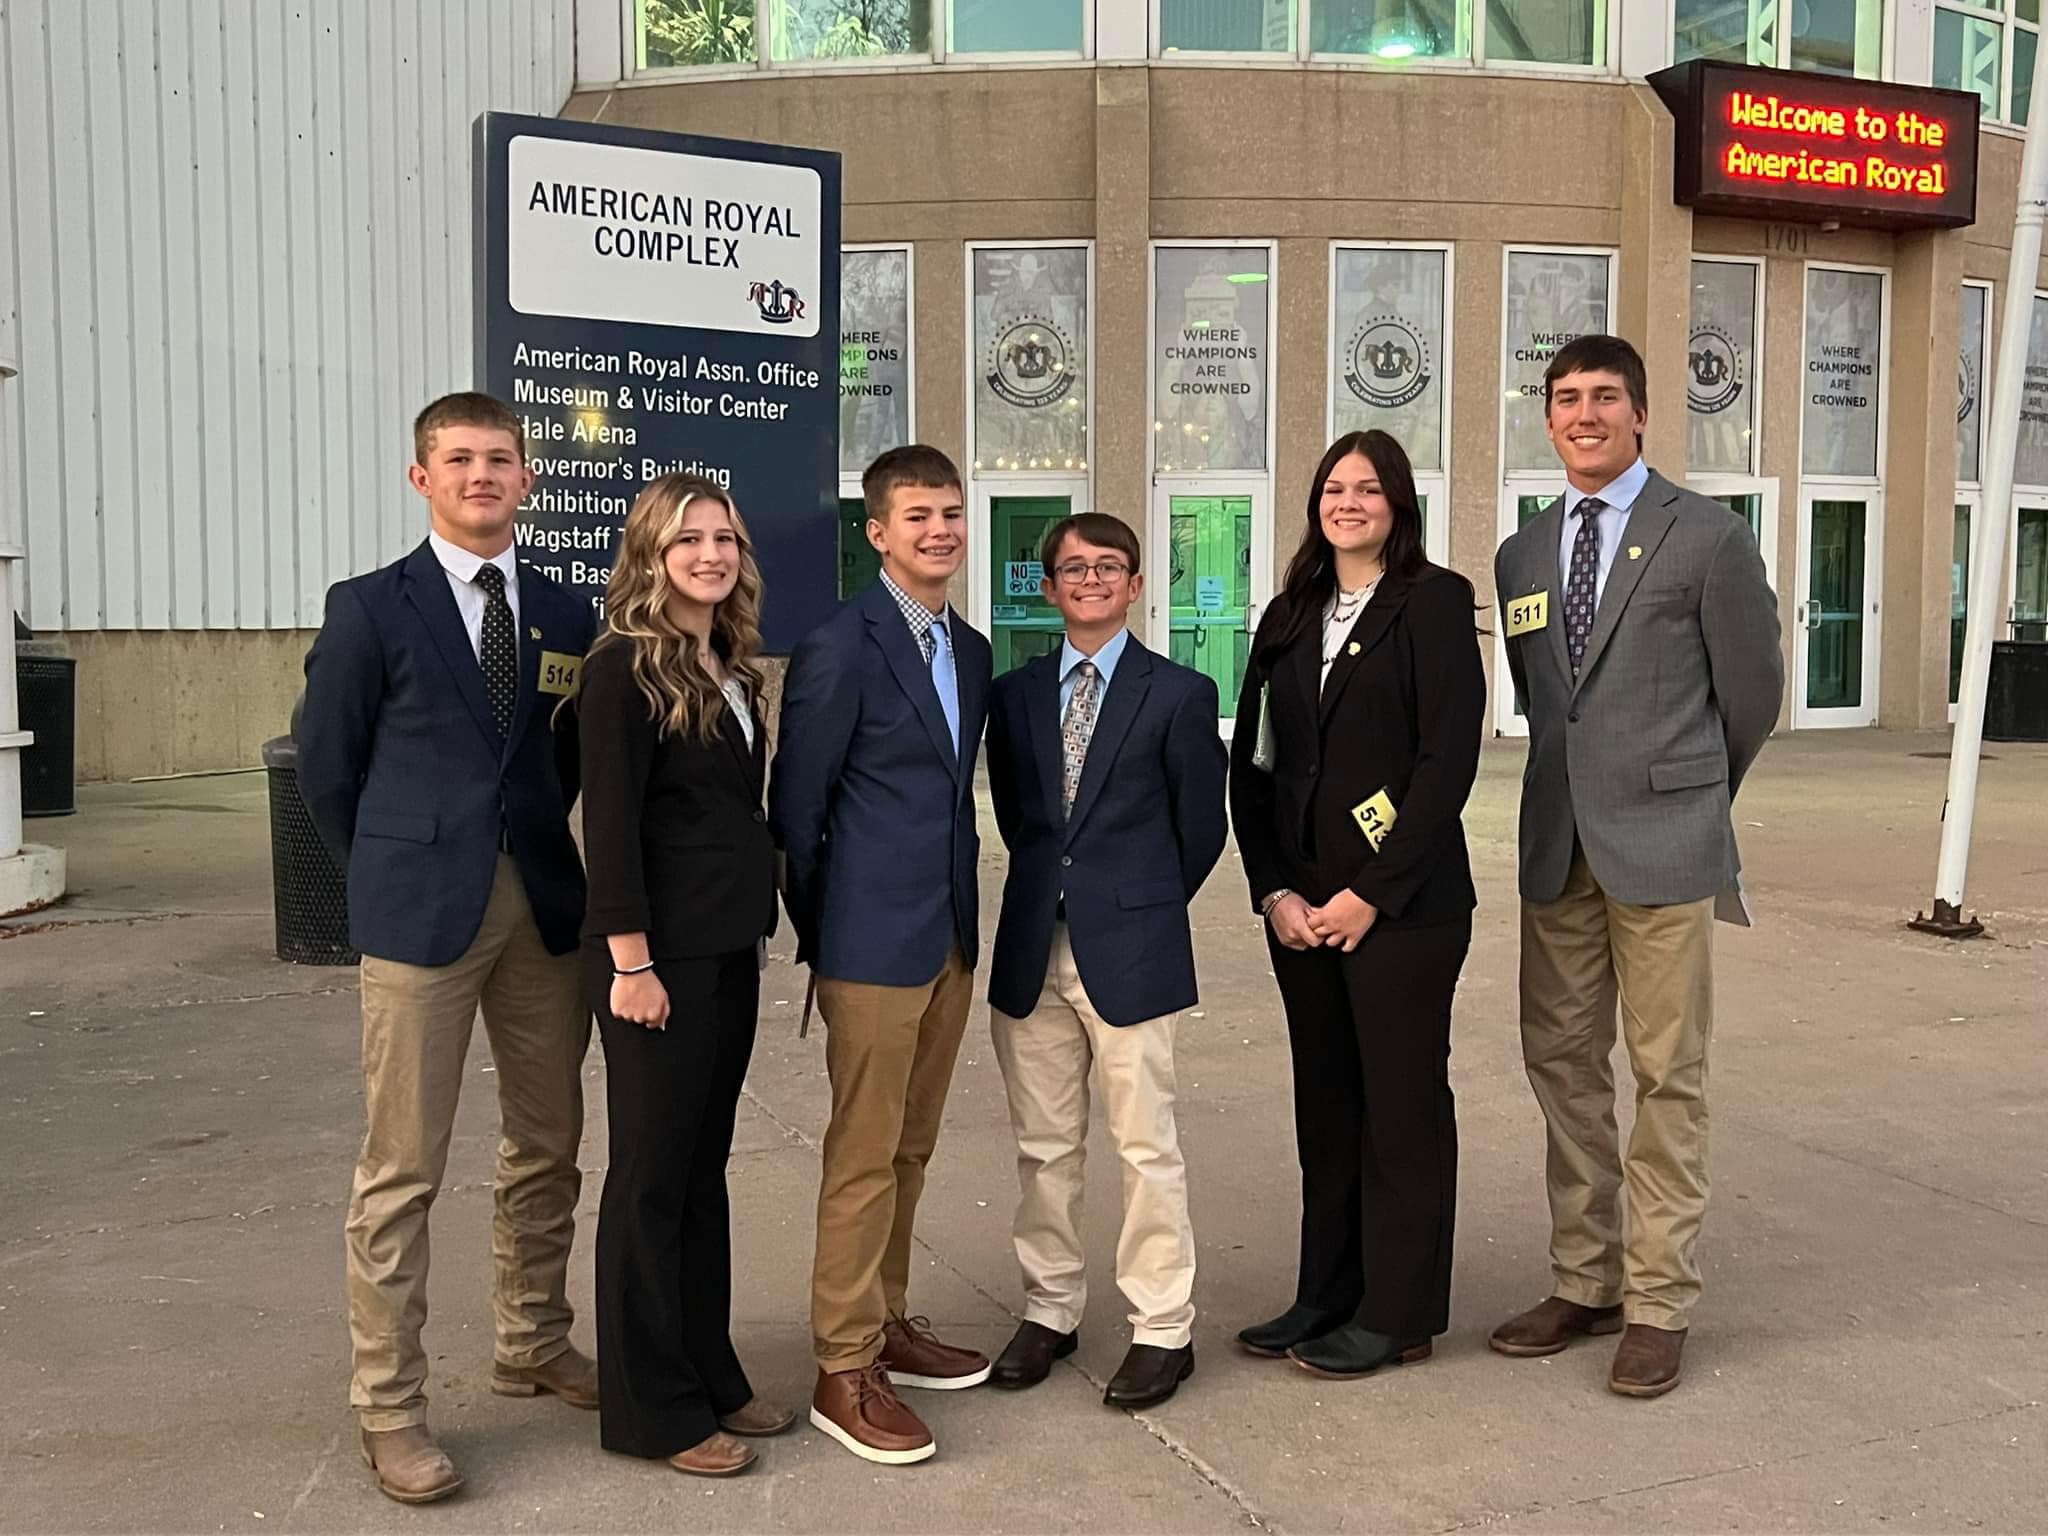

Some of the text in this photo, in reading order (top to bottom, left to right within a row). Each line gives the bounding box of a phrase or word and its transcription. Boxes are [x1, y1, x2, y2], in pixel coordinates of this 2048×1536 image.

[1732, 92, 1944, 146] Welcome to the
[1727, 142, 1944, 194] American Royal
[529, 181, 800, 238] AMERICAN ROYAL
[595, 226, 739, 269] COMPLEX
[841, 331, 880, 344] HERE
[1183, 329, 1240, 341] WHERE
[1532, 333, 1581, 344] WHER
[841, 349, 898, 360] MPIONS
[1165, 347, 1257, 359] CHAMPIONS
[1822, 345, 1861, 359] WHERE
[513, 342, 820, 388] American Royal Assn. Office
[1195, 365, 1226, 377] ARE
[1809, 361, 1872, 375] CHAMPIONS
[840, 367, 869, 379] ARE
[840, 384, 892, 397] OWNED
[1170, 383, 1251, 395] CROWNED
[1829, 379, 1851, 391] ARE
[514, 379, 789, 420] Museum & Visitor Center
[1812, 394, 1867, 408] CROWNED
[572, 418, 637, 445] Arena
[641, 457, 730, 490] Building
[513, 522, 611, 552] Wagstaff
[571, 560, 611, 585] Bas
[1011, 563, 1028, 579] NO
[1513, 602, 1541, 625] 511
[546, 664, 575, 687] 514
